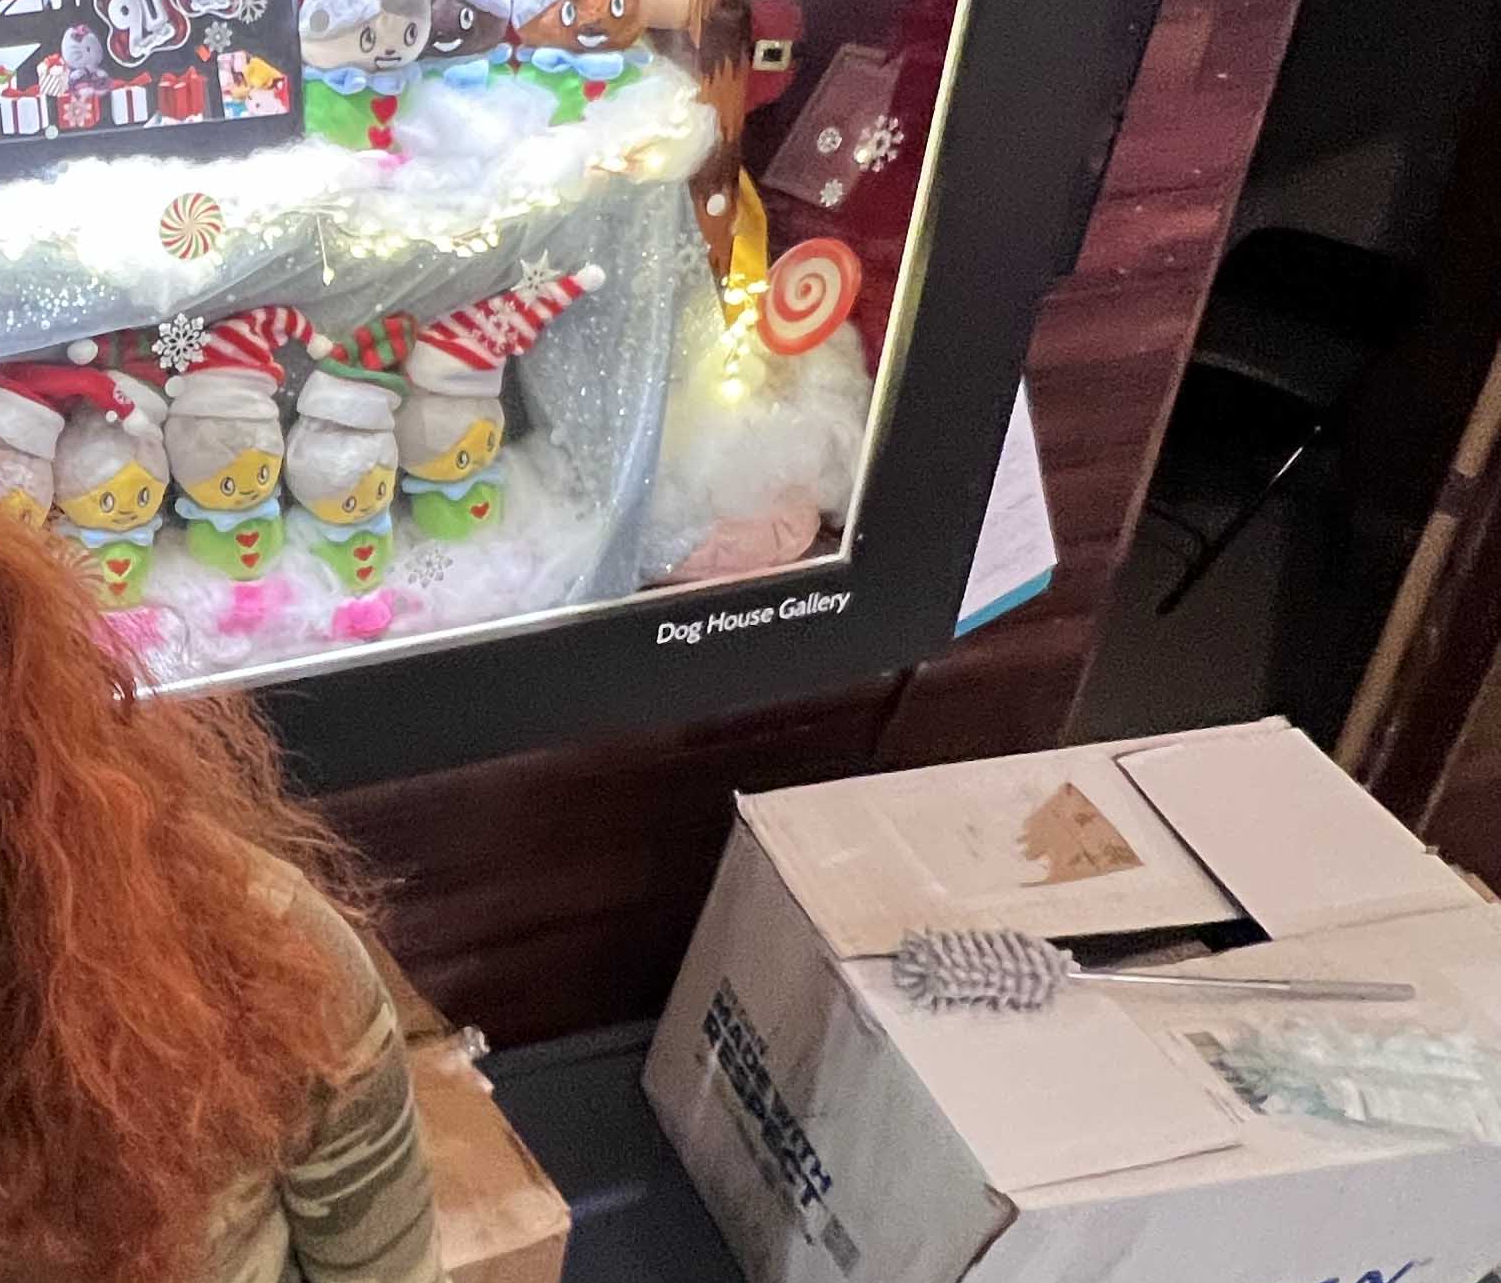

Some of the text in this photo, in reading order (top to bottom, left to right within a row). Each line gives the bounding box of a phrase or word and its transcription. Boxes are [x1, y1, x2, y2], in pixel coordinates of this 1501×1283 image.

[656, 589, 852, 645] Dog House Gallery
